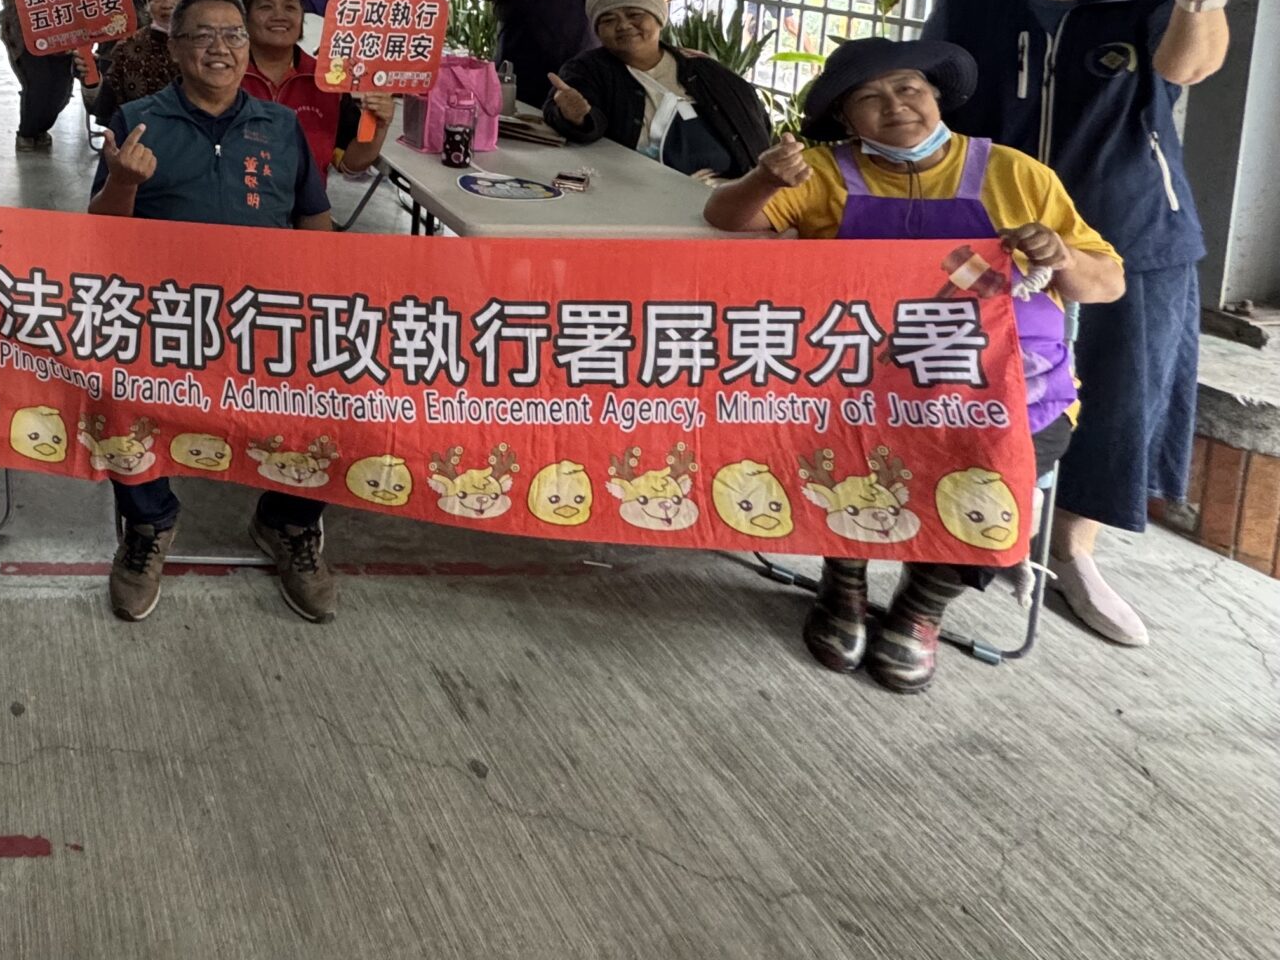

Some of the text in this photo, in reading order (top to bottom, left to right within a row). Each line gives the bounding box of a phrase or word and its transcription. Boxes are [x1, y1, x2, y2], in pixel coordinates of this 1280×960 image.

[336, 0, 440, 29] 行政執行
[331, 31, 434, 61] 給您屏安
[111, 367, 211, 411] Branch,
[220, 378, 417, 423] Administrative
[425, 390, 591, 426] Enforcement
[602, 393, 706, 431] Agency,
[718, 393, 830, 434] Ministry
[842, 393, 876, 426] of
[888, 394, 1008, 429] Justice
